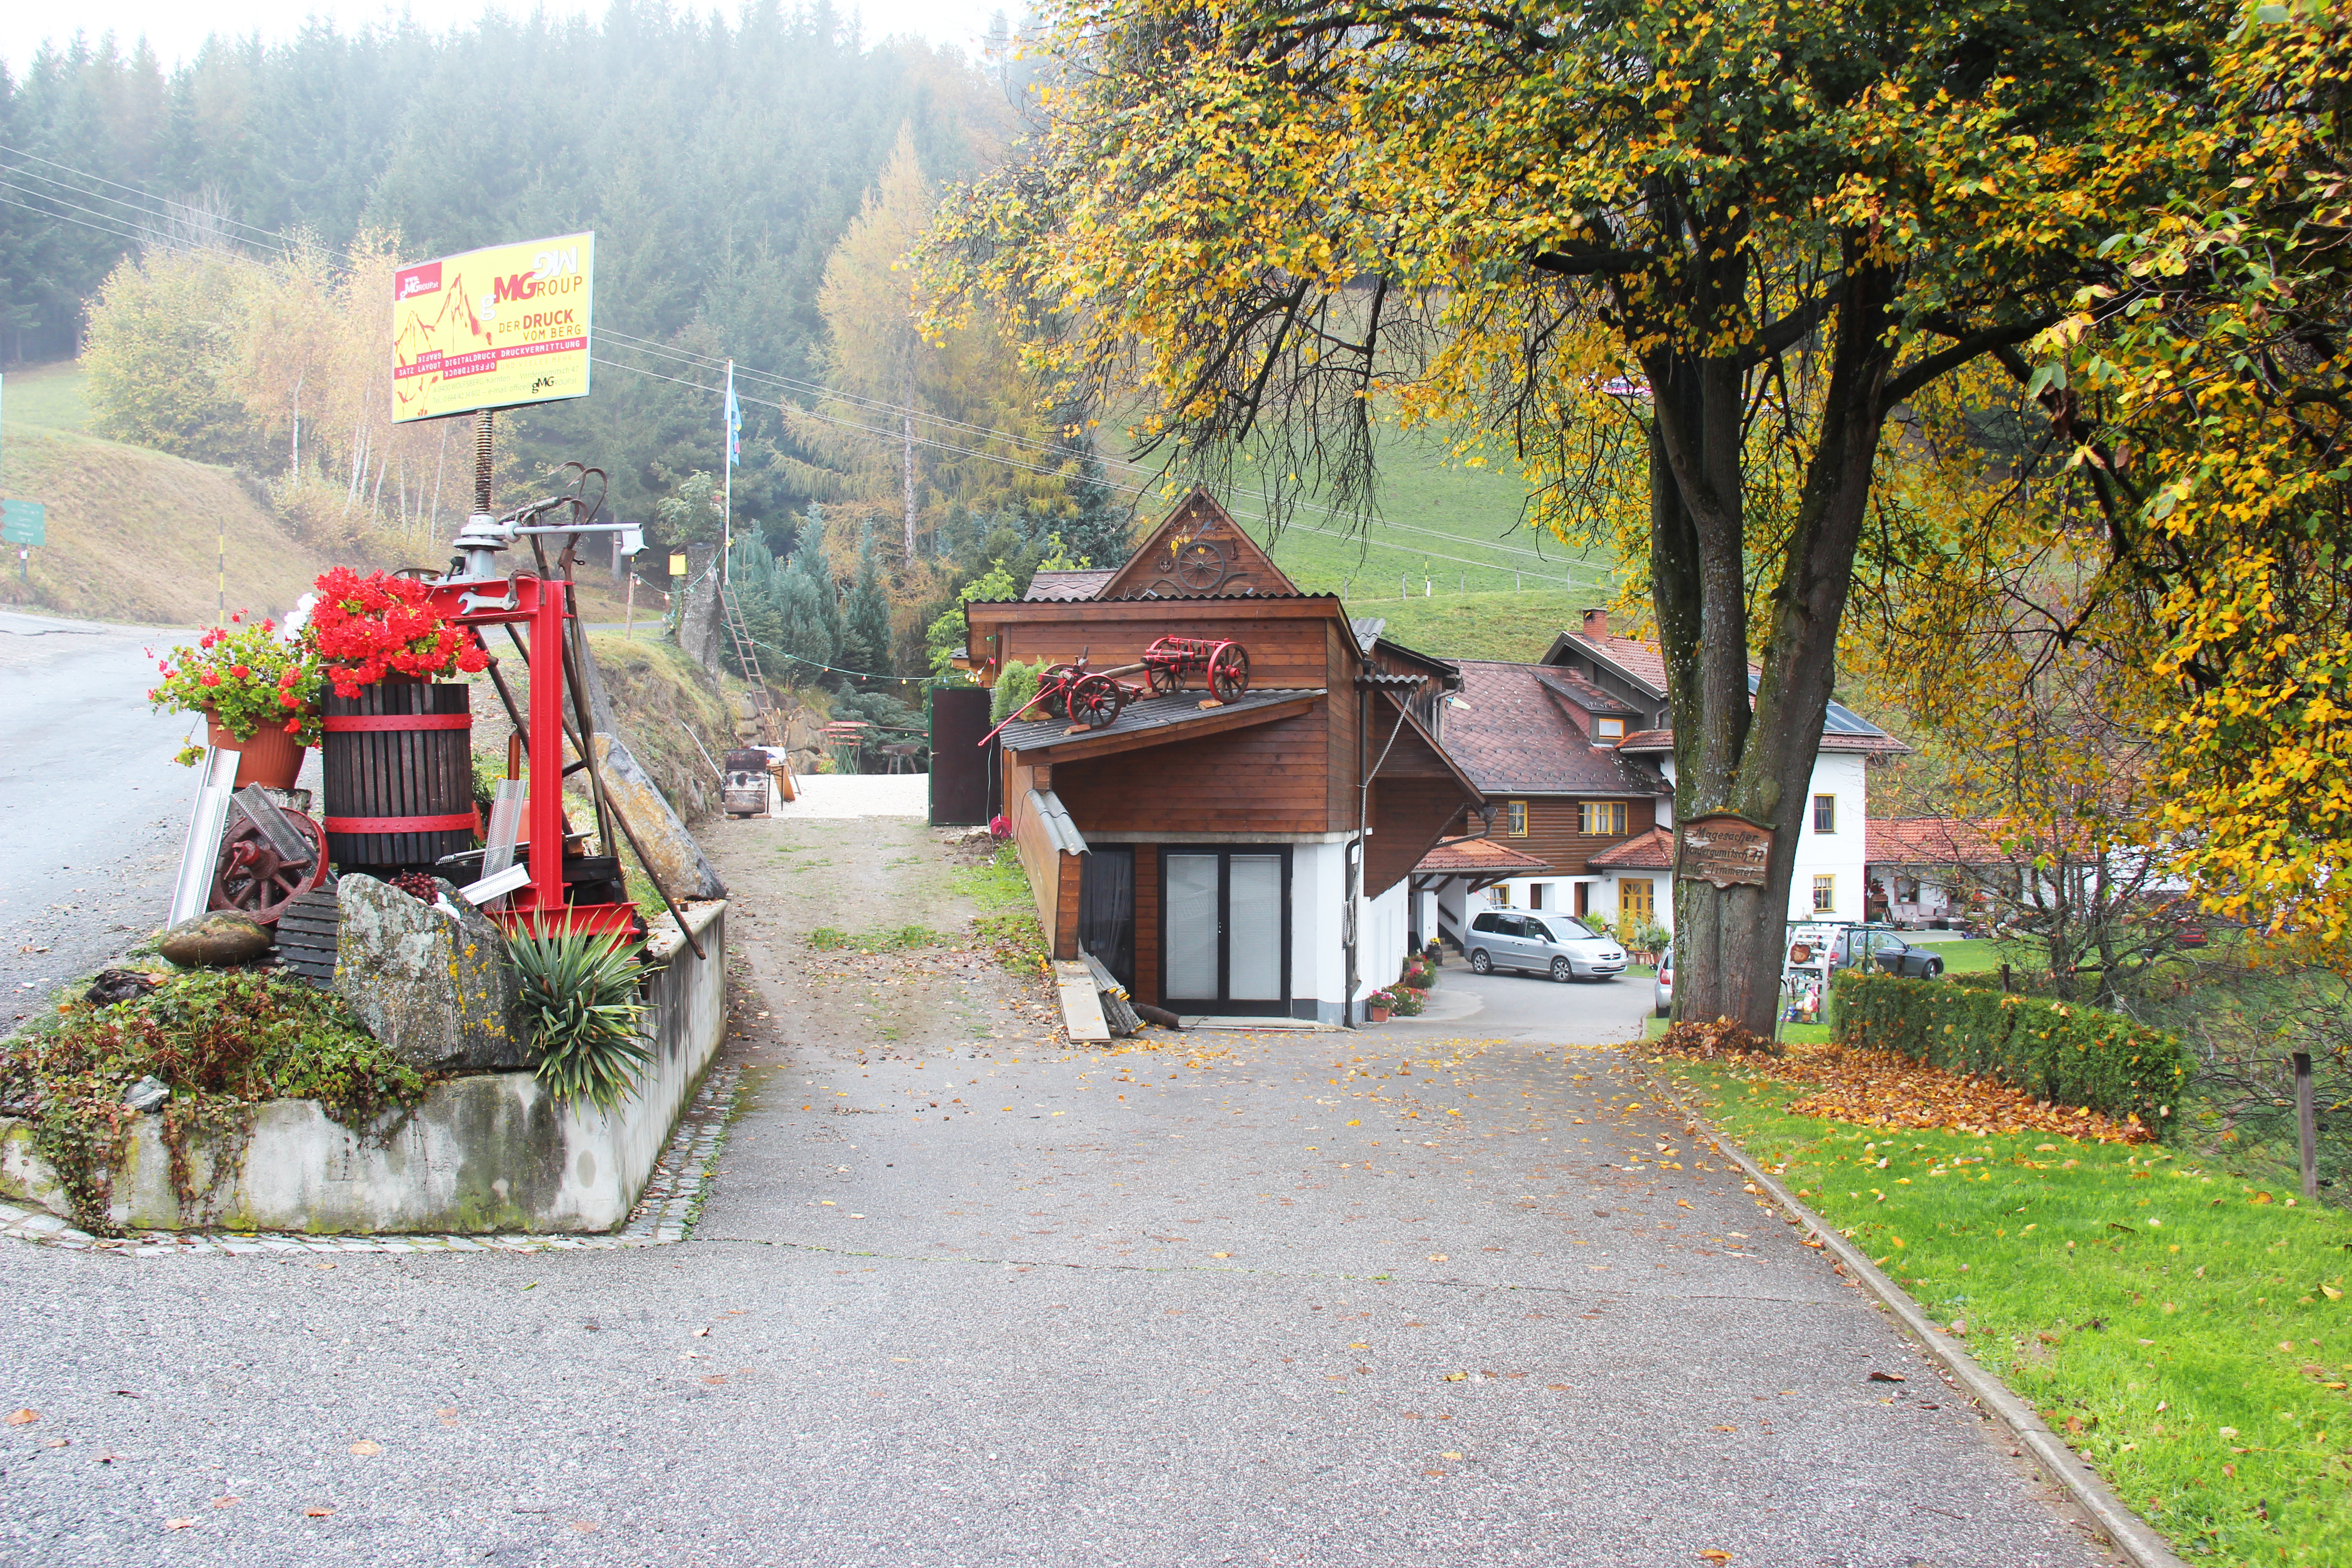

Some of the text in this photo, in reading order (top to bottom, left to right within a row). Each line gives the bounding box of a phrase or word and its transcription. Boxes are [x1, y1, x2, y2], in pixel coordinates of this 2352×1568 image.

[499, 309, 574, 333] DER DRUCK
[523, 324, 581, 341] VOM BERG
[399, 340, 580, 376] SATZ LAYOUT DIGITALDRUCK DRUCKVERMITTLUNG
[519, 358, 549, 368] VIELES
[1693, 826, 1760, 844] Magesacher
[1685, 842, 1764, 862] Vordergumitsch 47
